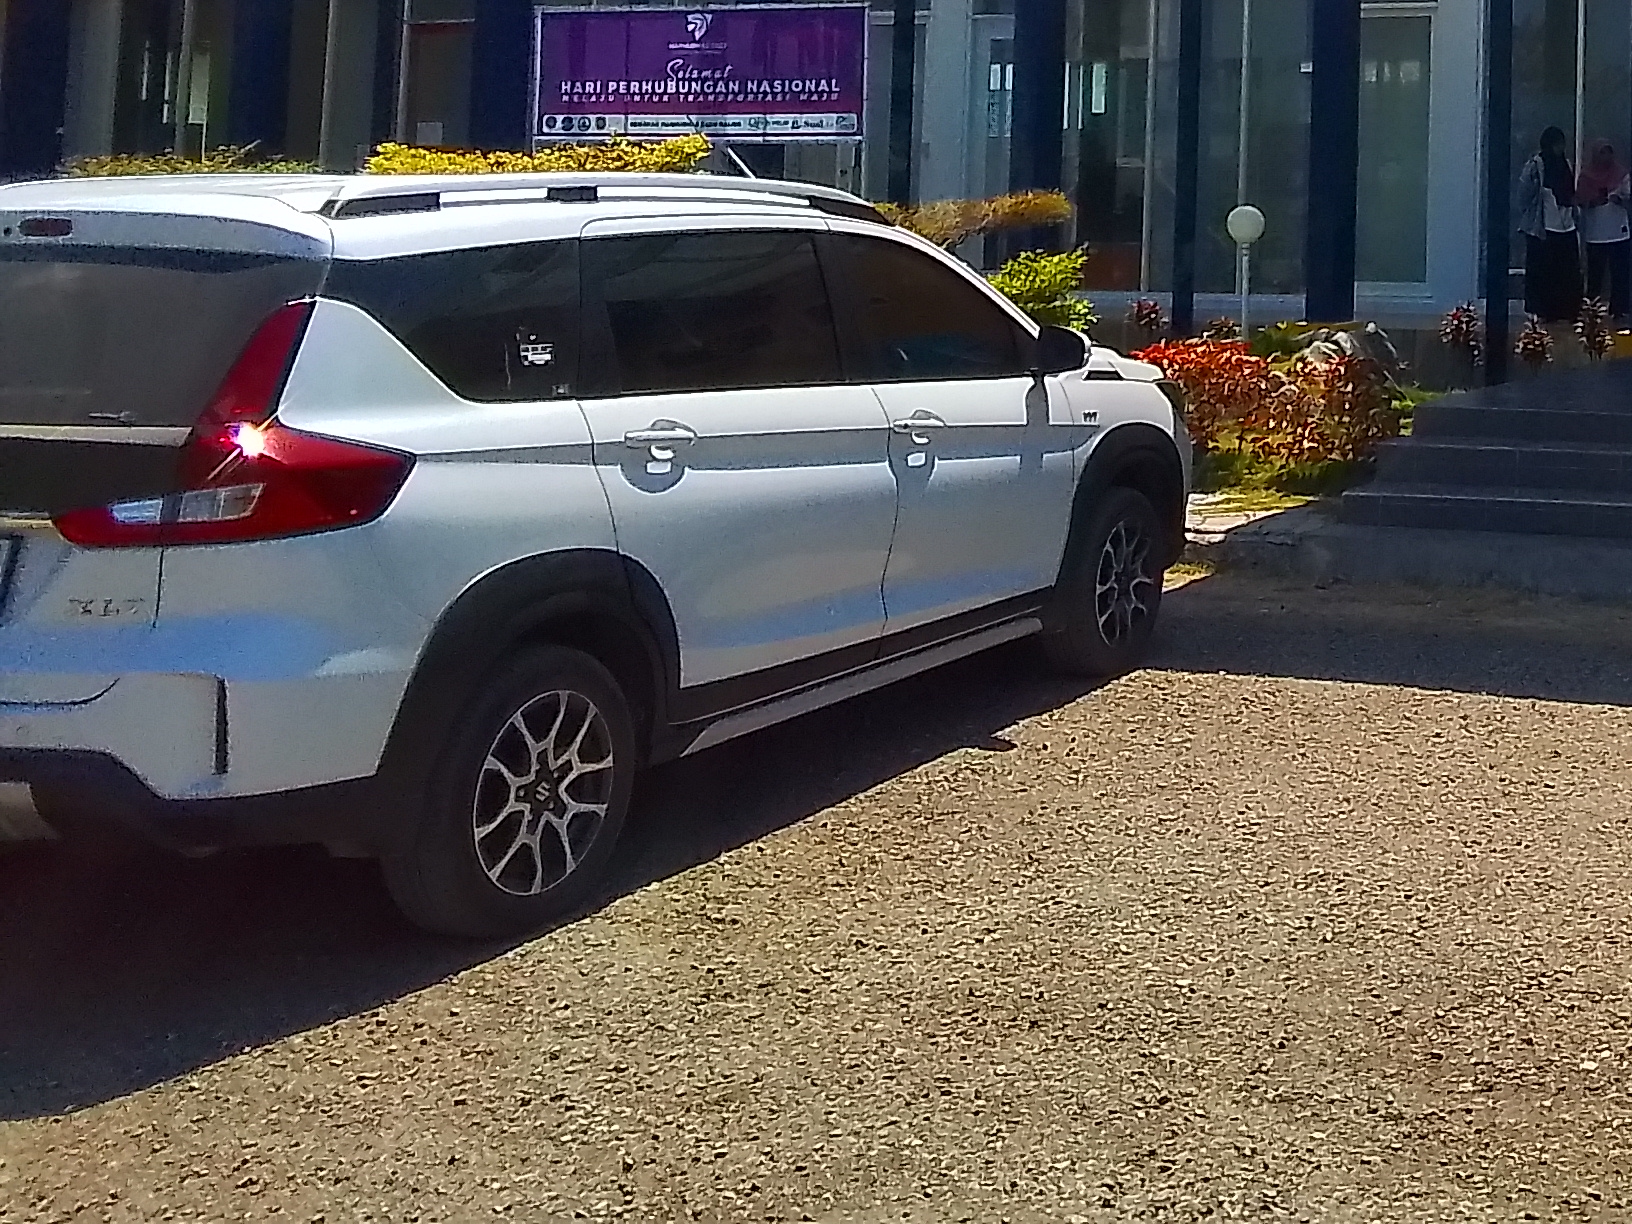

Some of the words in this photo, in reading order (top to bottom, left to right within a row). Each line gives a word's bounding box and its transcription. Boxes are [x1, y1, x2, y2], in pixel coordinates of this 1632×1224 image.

[560, 80, 602, 94] HARI
[607, 79, 739, 94] PERHUBUNGAN
[747, 78, 841, 93] NASIONAL
